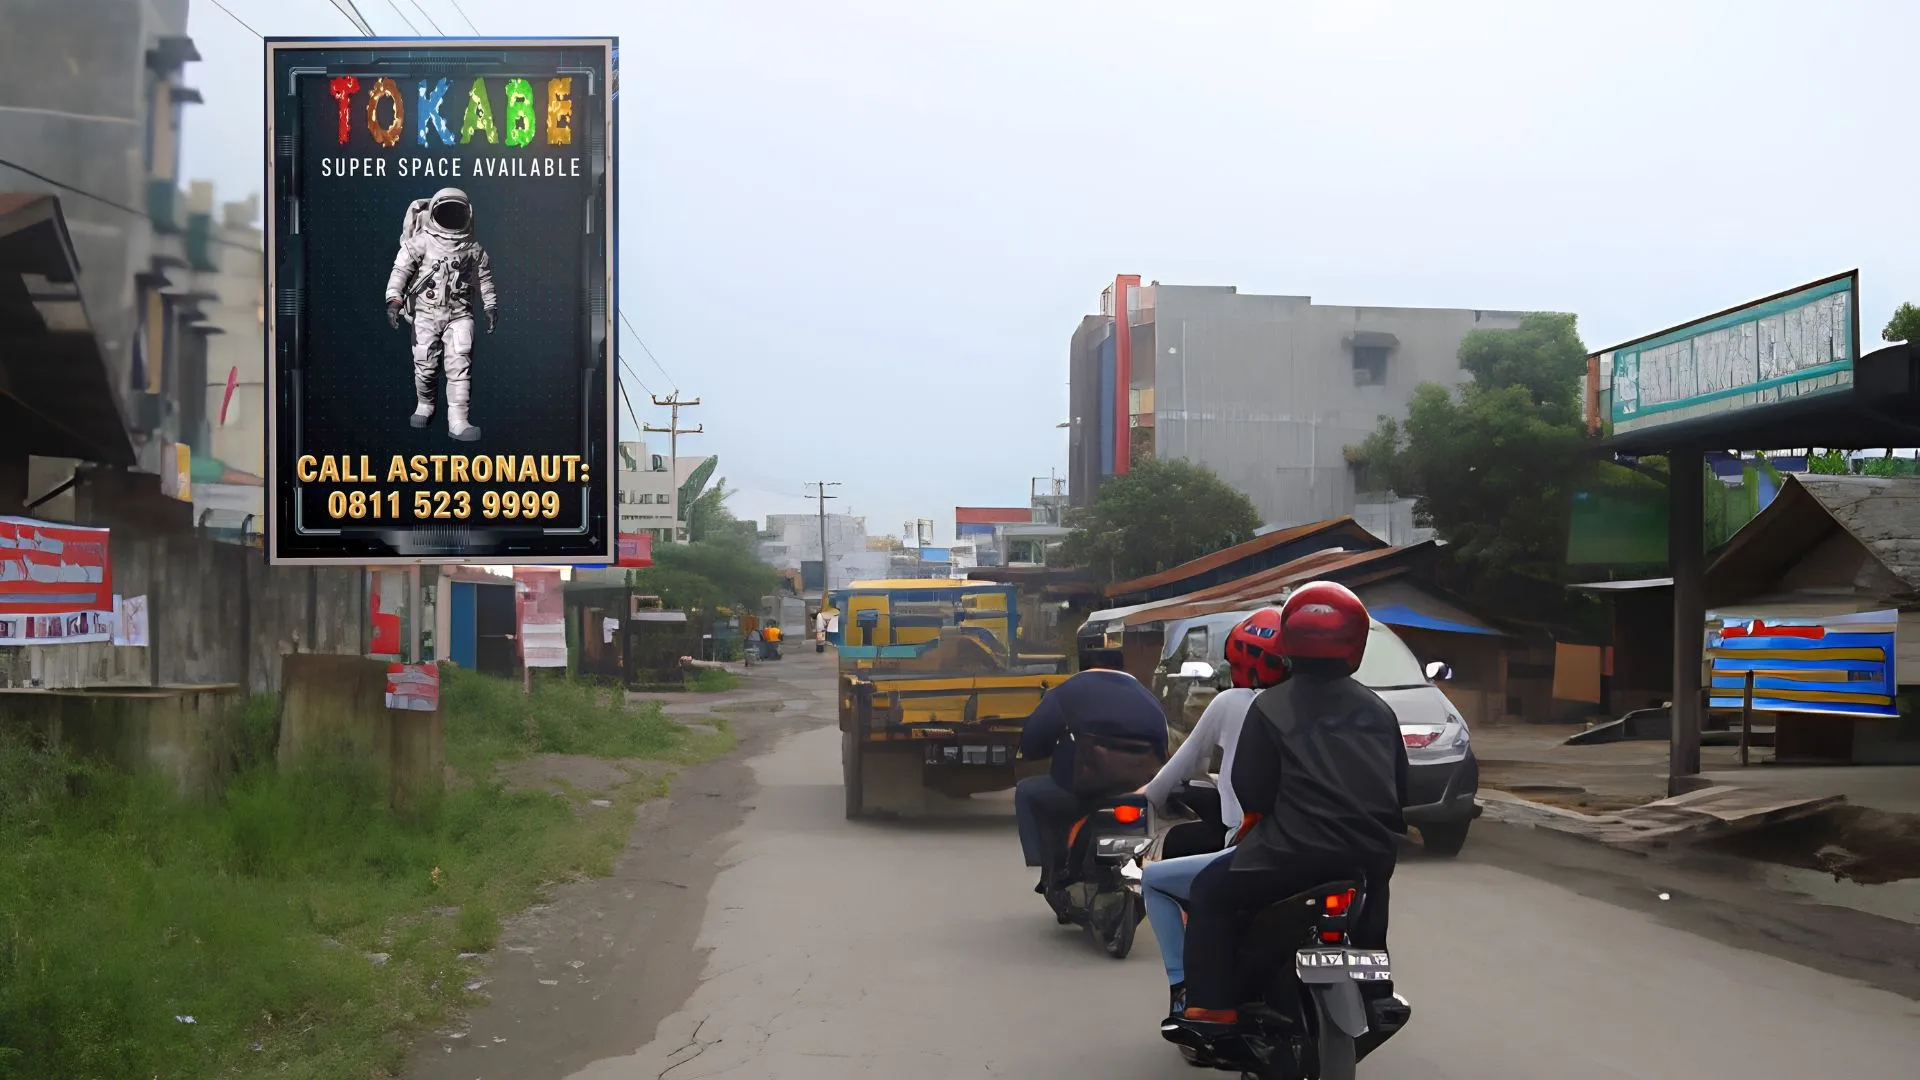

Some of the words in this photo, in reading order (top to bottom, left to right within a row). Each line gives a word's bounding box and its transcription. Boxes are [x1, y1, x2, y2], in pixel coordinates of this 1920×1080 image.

[329, 74, 573, 148] TOKABE
[321, 157, 386, 177] SUPER
[398, 157, 462, 177] SPACE
[472, 157, 580, 177] AVAILABLE
[297, 454, 377, 483] CALL
[386, 454, 590, 483] ASTRONAUT:
[328, 490, 400, 519] 0811
[413, 490, 472, 519] 523
[482, 490, 560, 519] 9999
